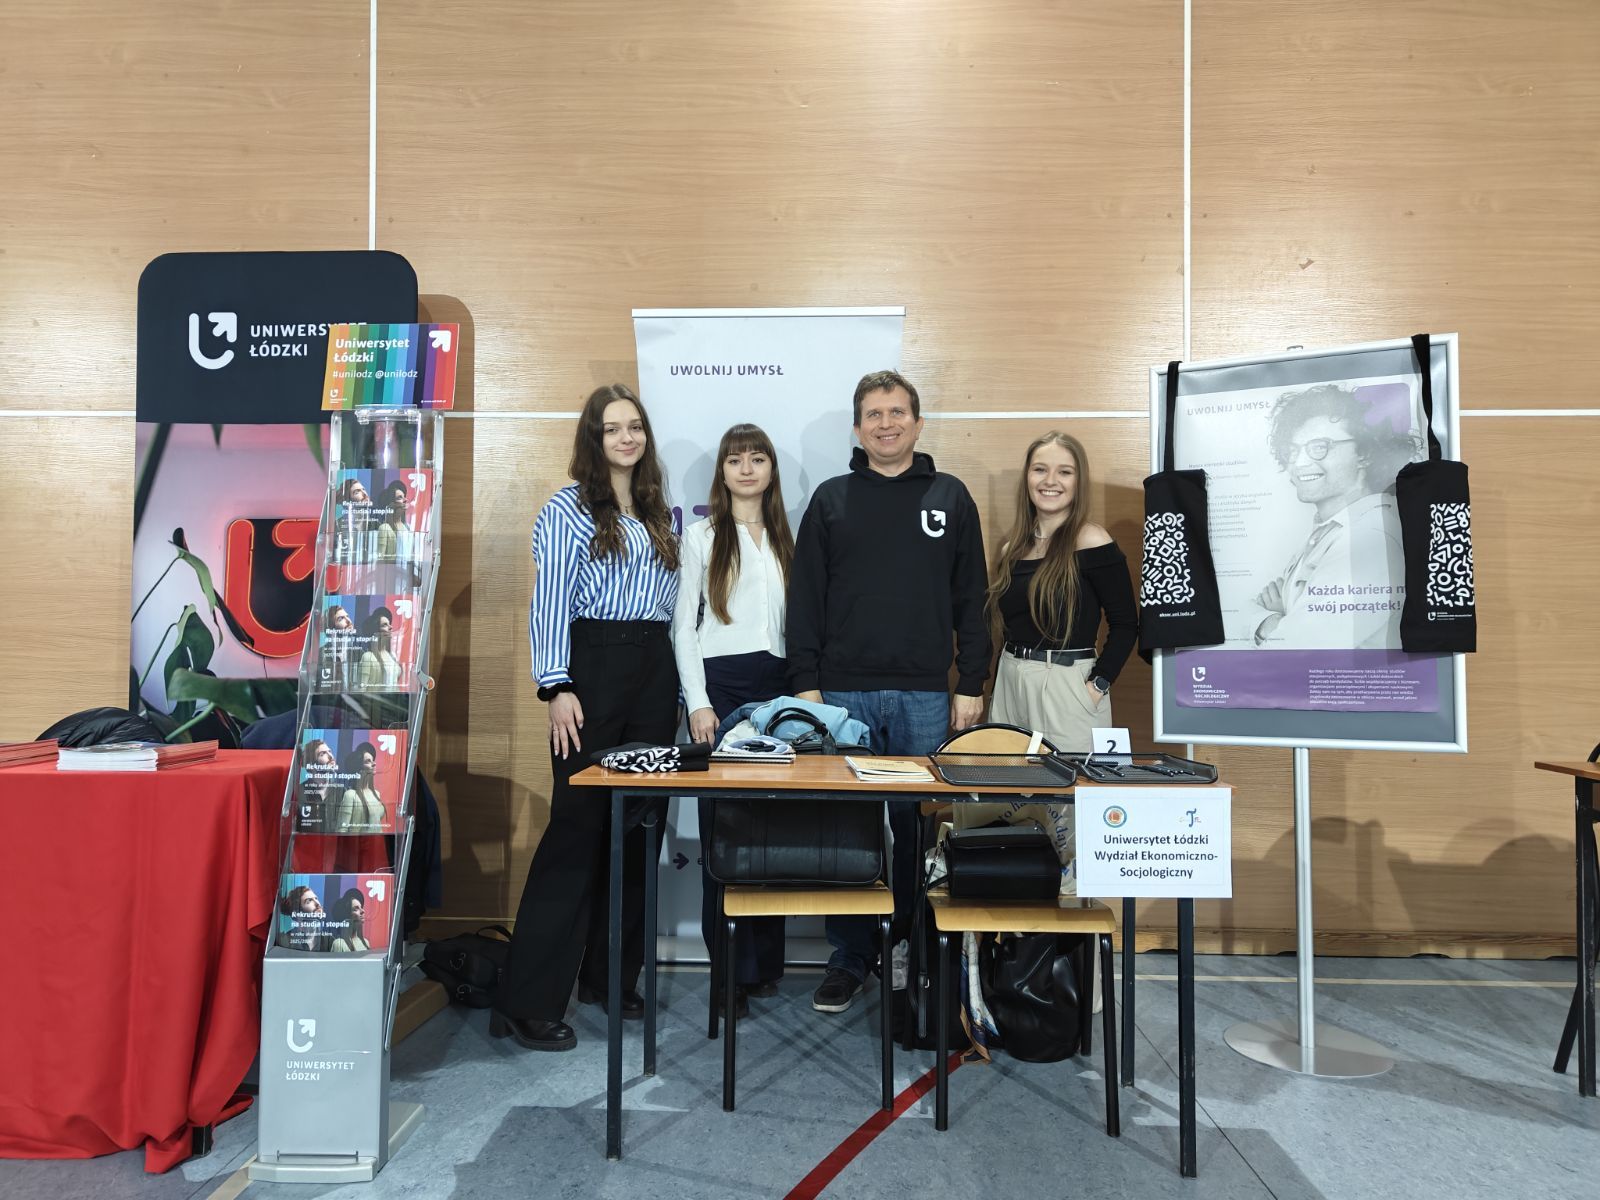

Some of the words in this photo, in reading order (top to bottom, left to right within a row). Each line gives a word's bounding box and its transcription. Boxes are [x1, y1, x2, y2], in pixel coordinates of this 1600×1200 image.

[250, 322, 367, 338] UNIWERS
[249, 341, 308, 357] ŁÓDZKI
[335, 338, 410, 351] Uniwersytet
[333, 351, 374, 363] Łódzki
[332, 369, 372, 378] #unilodz
[375, 369, 418, 379] @unilodz
[670, 364, 732, 376] UWOLNIJ
[737, 364, 784, 376] UMYSŁ
[1187, 405, 1233, 416] UWOLNIJ
[1236, 401, 1271, 411] UMYSŁ
[1307, 584, 1345, 596] Każda
[1348, 584, 1393, 595] kariera
[1307, 601, 1337, 613] swój
[1339, 600, 1401, 613] początek!
[1106, 739, 1118, 753] 2
[306, 763, 339, 771] Rekrutacja
[338, 772, 361, 780] stopnia
[1103, 834, 1170, 846] Uniwersytet
[1174, 834, 1209, 845] Łódzki
[1094, 850, 1138, 863] Wydział
[1141, 850, 1218, 861] Ekonomiczno-
[1120, 867, 1193, 879] Socjologiczny
[291, 911, 326, 919] Rekrutacja
[326, 920, 350, 928] stopnia
[286, 1060, 355, 1070] UNIWERSYTET
[286, 1069, 320, 1081] ŁÓDZKI
